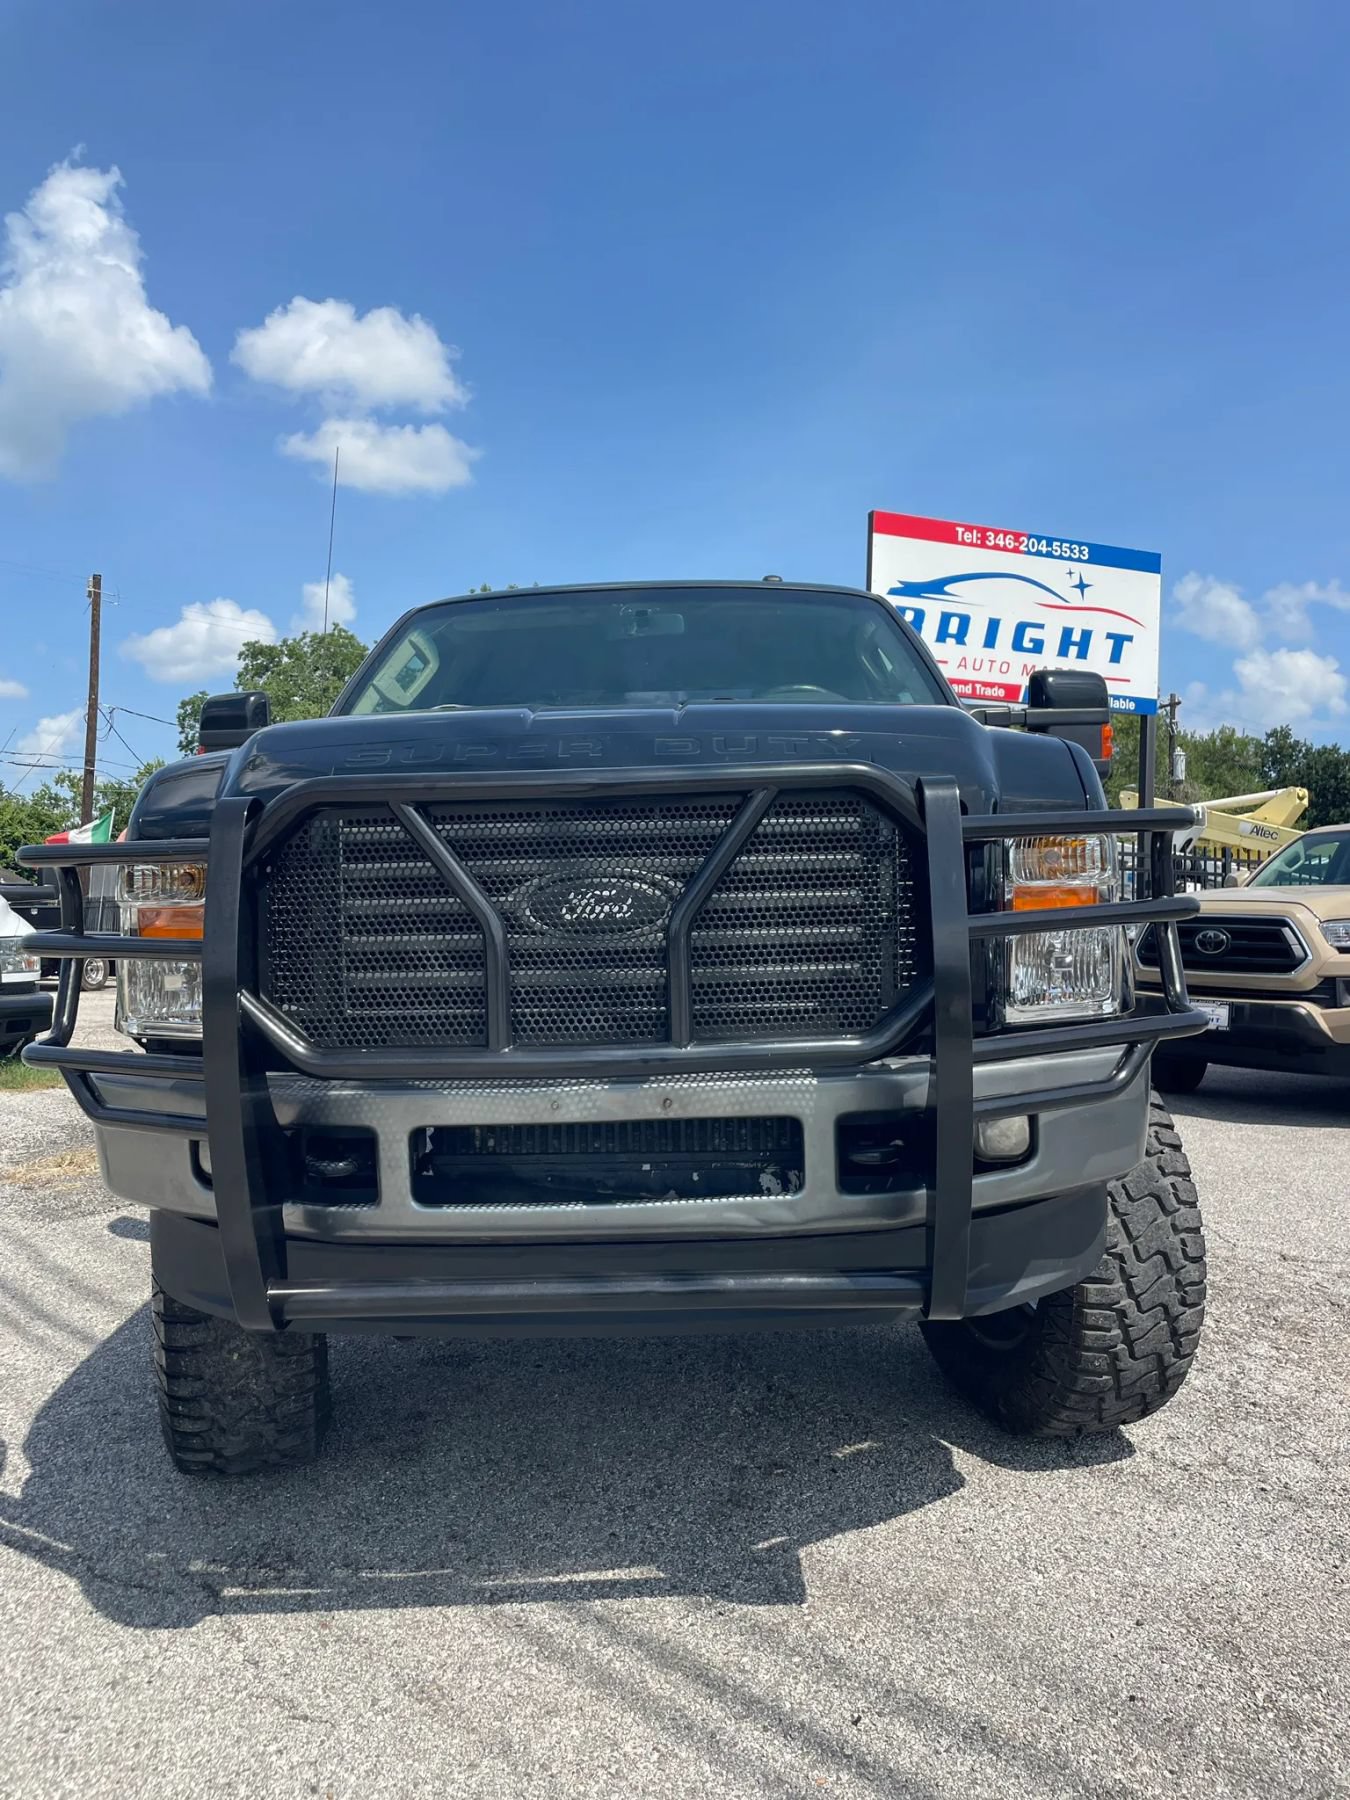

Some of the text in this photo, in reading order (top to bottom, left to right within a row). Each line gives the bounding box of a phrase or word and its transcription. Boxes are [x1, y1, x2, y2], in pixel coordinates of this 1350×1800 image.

[955, 526, 1089, 560] Tel: 346-204-5533
[957, 656, 1011, 675] AUTO
[974, 683, 1006, 698] Trade
[344, 736, 862, 767] SUPER DUTY
[1250, 825, 1279, 841] Altec
